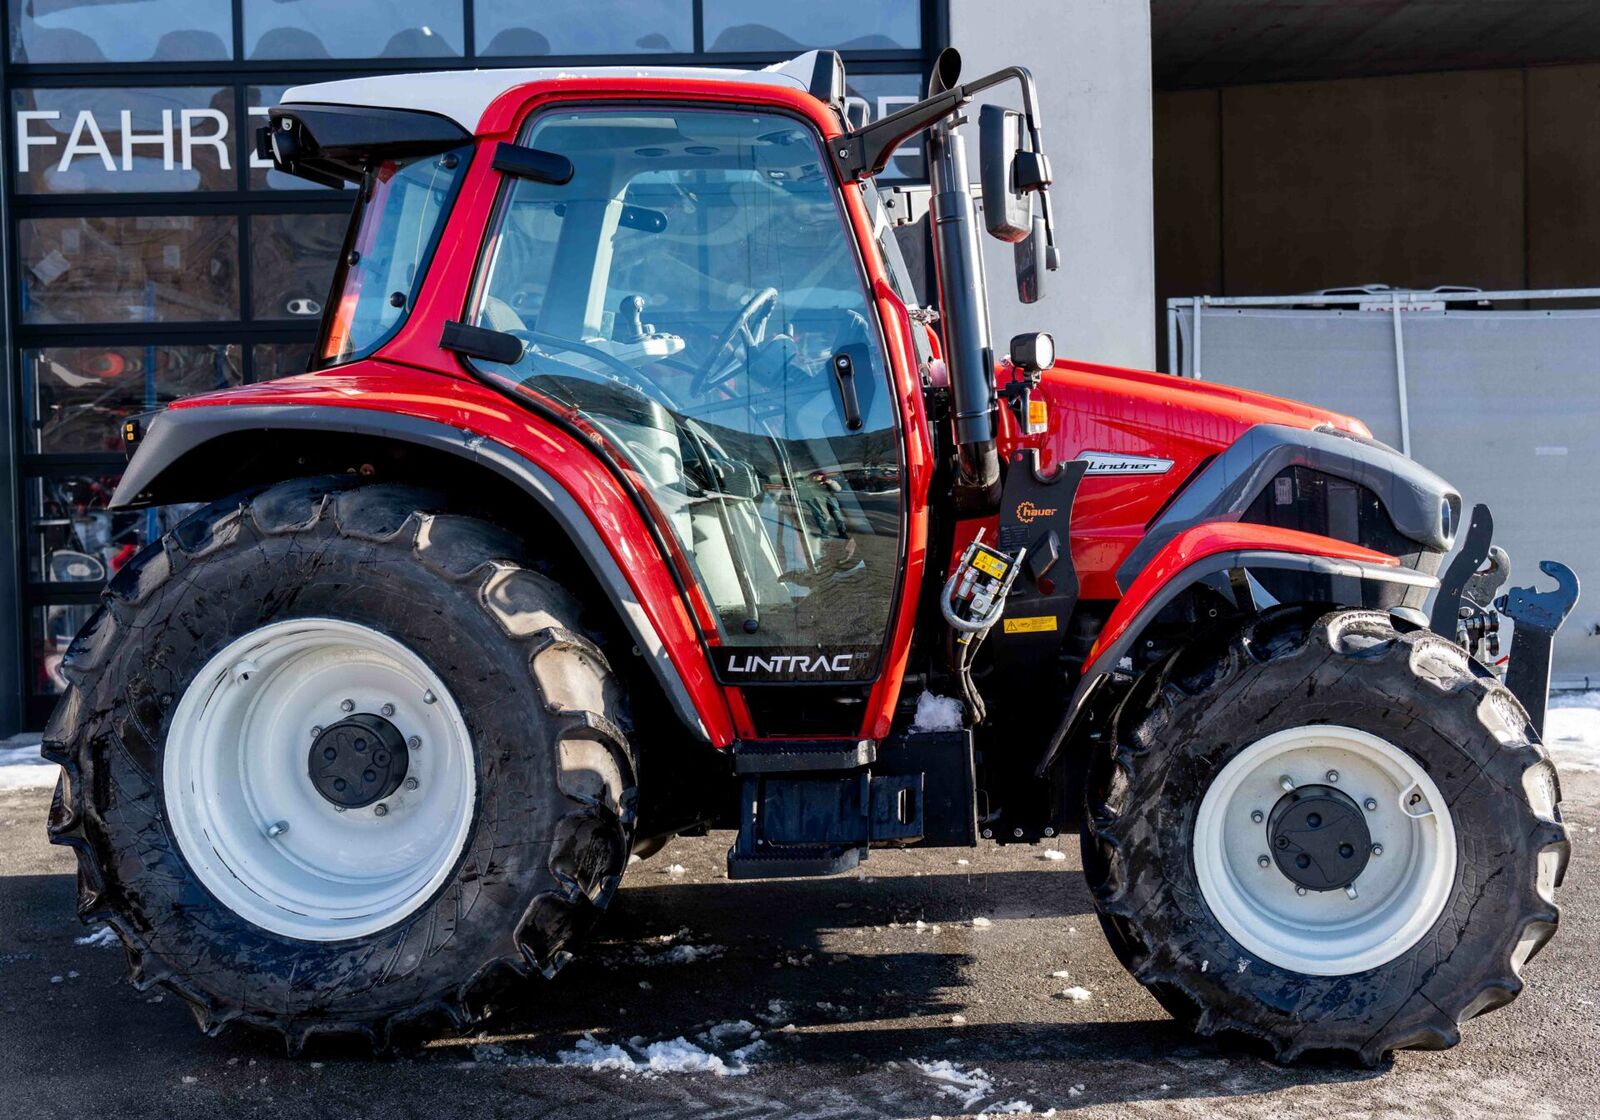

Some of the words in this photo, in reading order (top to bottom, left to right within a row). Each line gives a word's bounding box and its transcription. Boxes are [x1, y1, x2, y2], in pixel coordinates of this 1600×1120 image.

[1088, 461, 1157, 470] Lindner
[1022, 506, 1058, 516] hauer
[728, 655, 852, 673] LINTRAC
